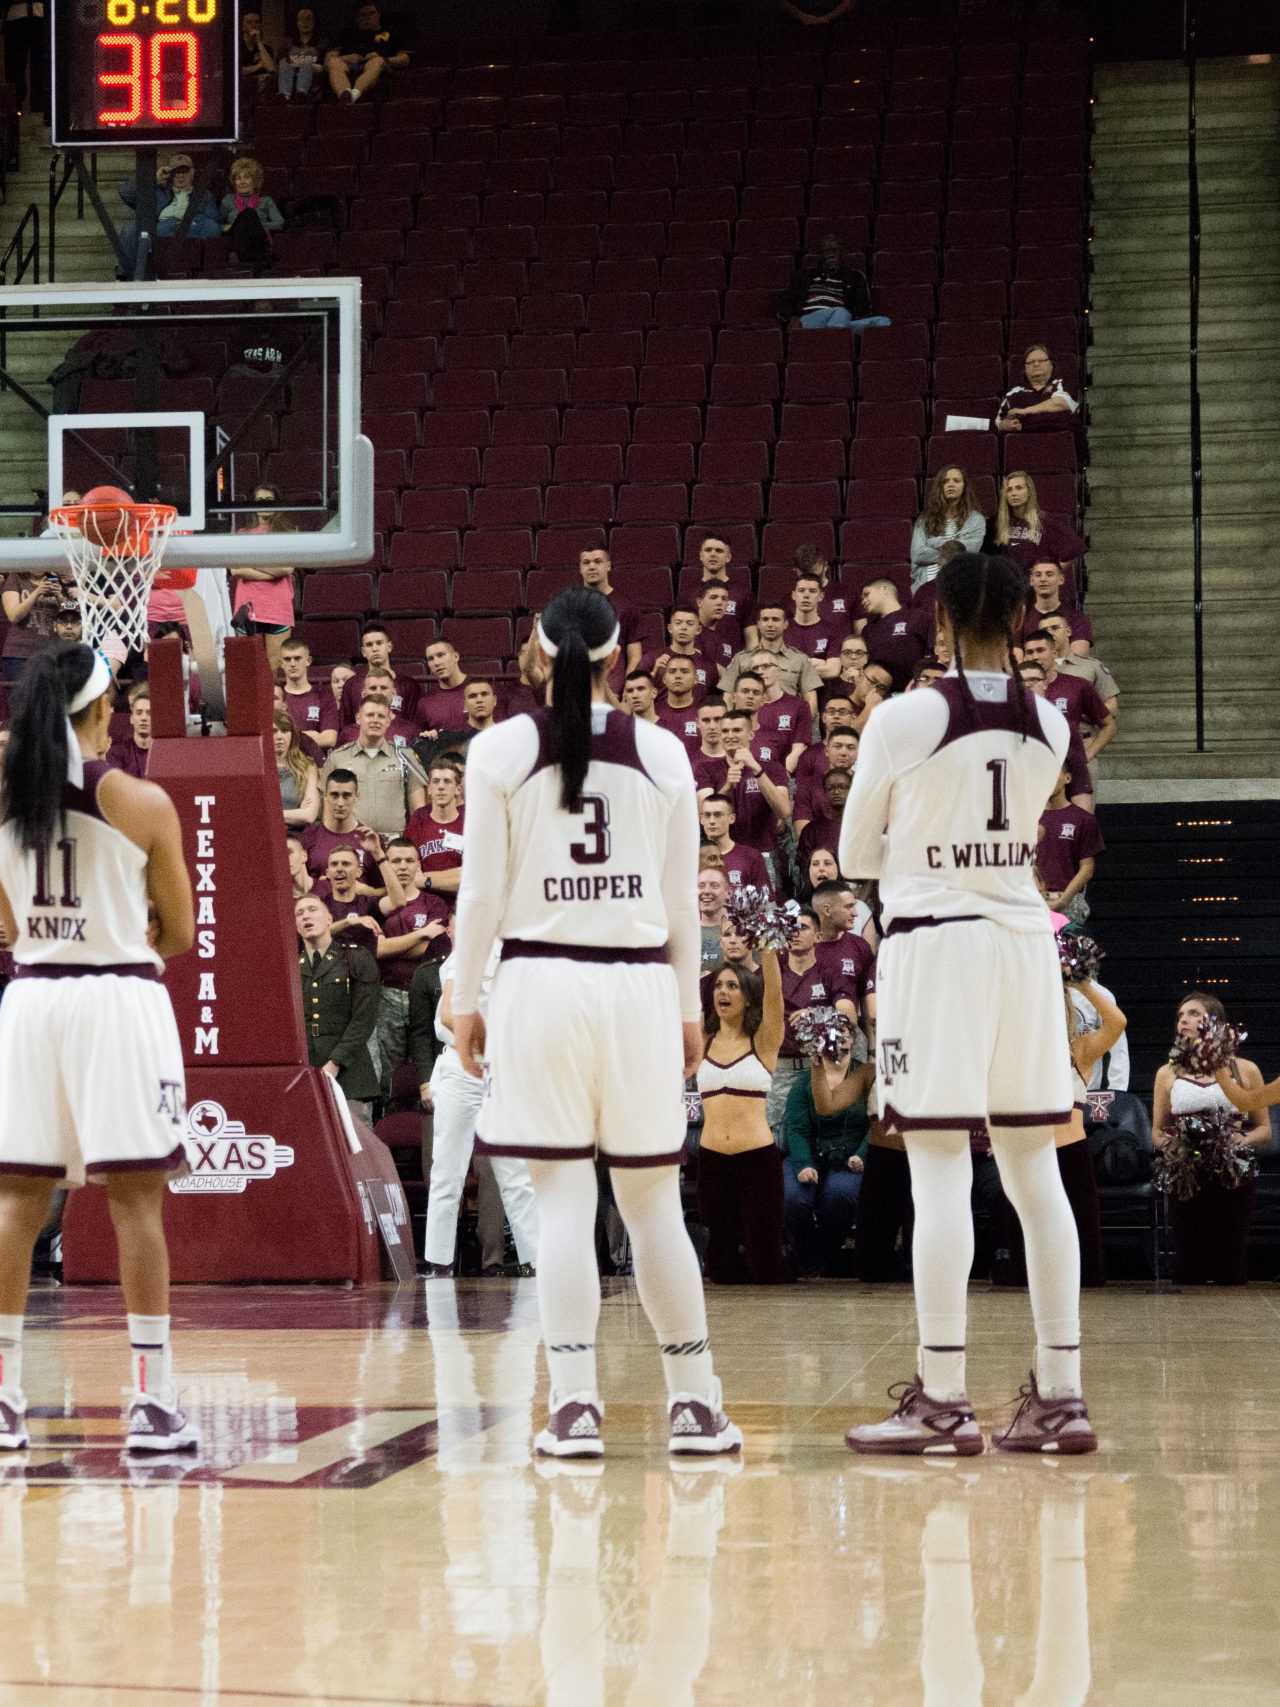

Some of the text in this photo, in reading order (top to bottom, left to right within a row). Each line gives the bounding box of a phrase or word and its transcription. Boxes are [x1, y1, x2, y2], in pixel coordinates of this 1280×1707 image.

[97, 33, 198, 122] 30
[568, 791, 611, 865] 3
[986, 758, 1009, 831] 1
[32, 837, 81, 908] 11
[194, 795, 217, 959] TEXAS
[543, 874, 643, 902] COOPER
[27, 916, 86, 941] KNOX
[195, 1141, 267, 1171] XAS
